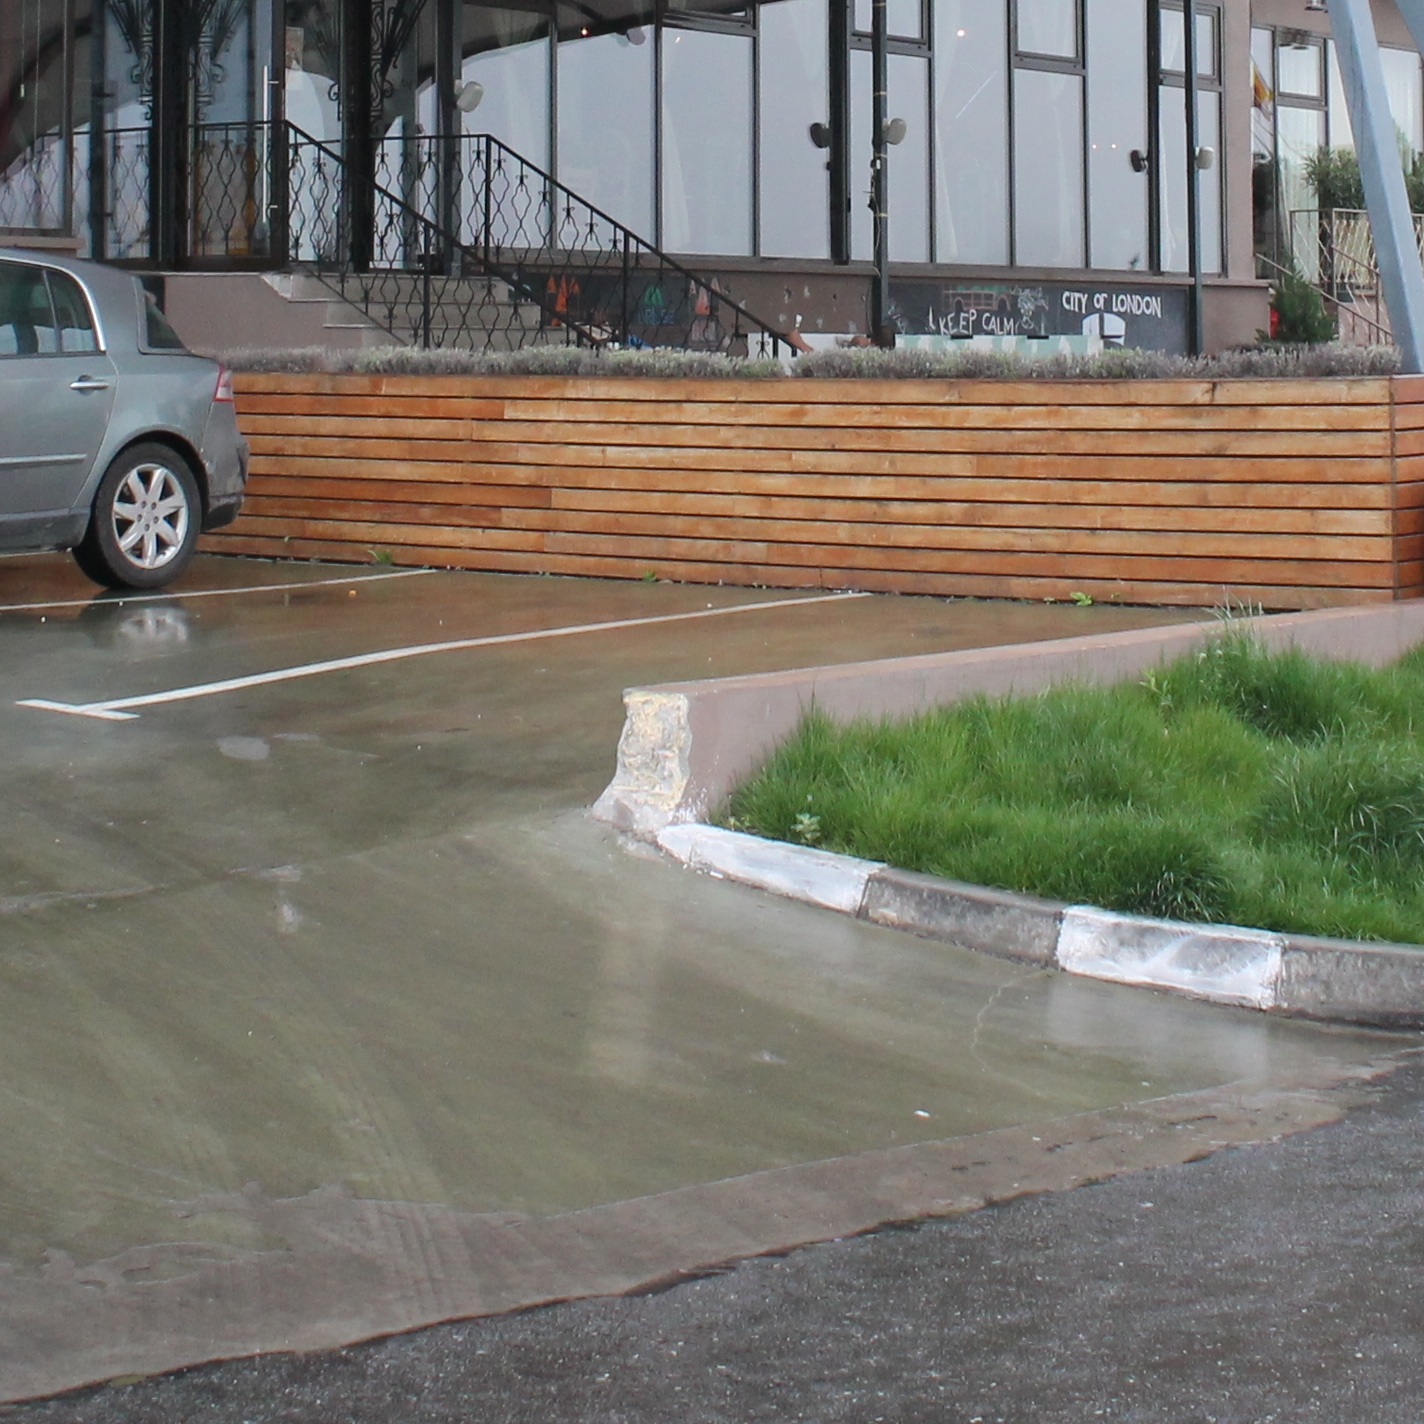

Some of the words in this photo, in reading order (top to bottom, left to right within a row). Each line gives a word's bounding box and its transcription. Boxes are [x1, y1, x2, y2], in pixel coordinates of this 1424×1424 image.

[1062, 291, 1088, 314] CITY
[1112, 294, 1161, 318] LONDON
[939, 309, 977, 336] KEEP
[982, 312, 1014, 335] CALM
